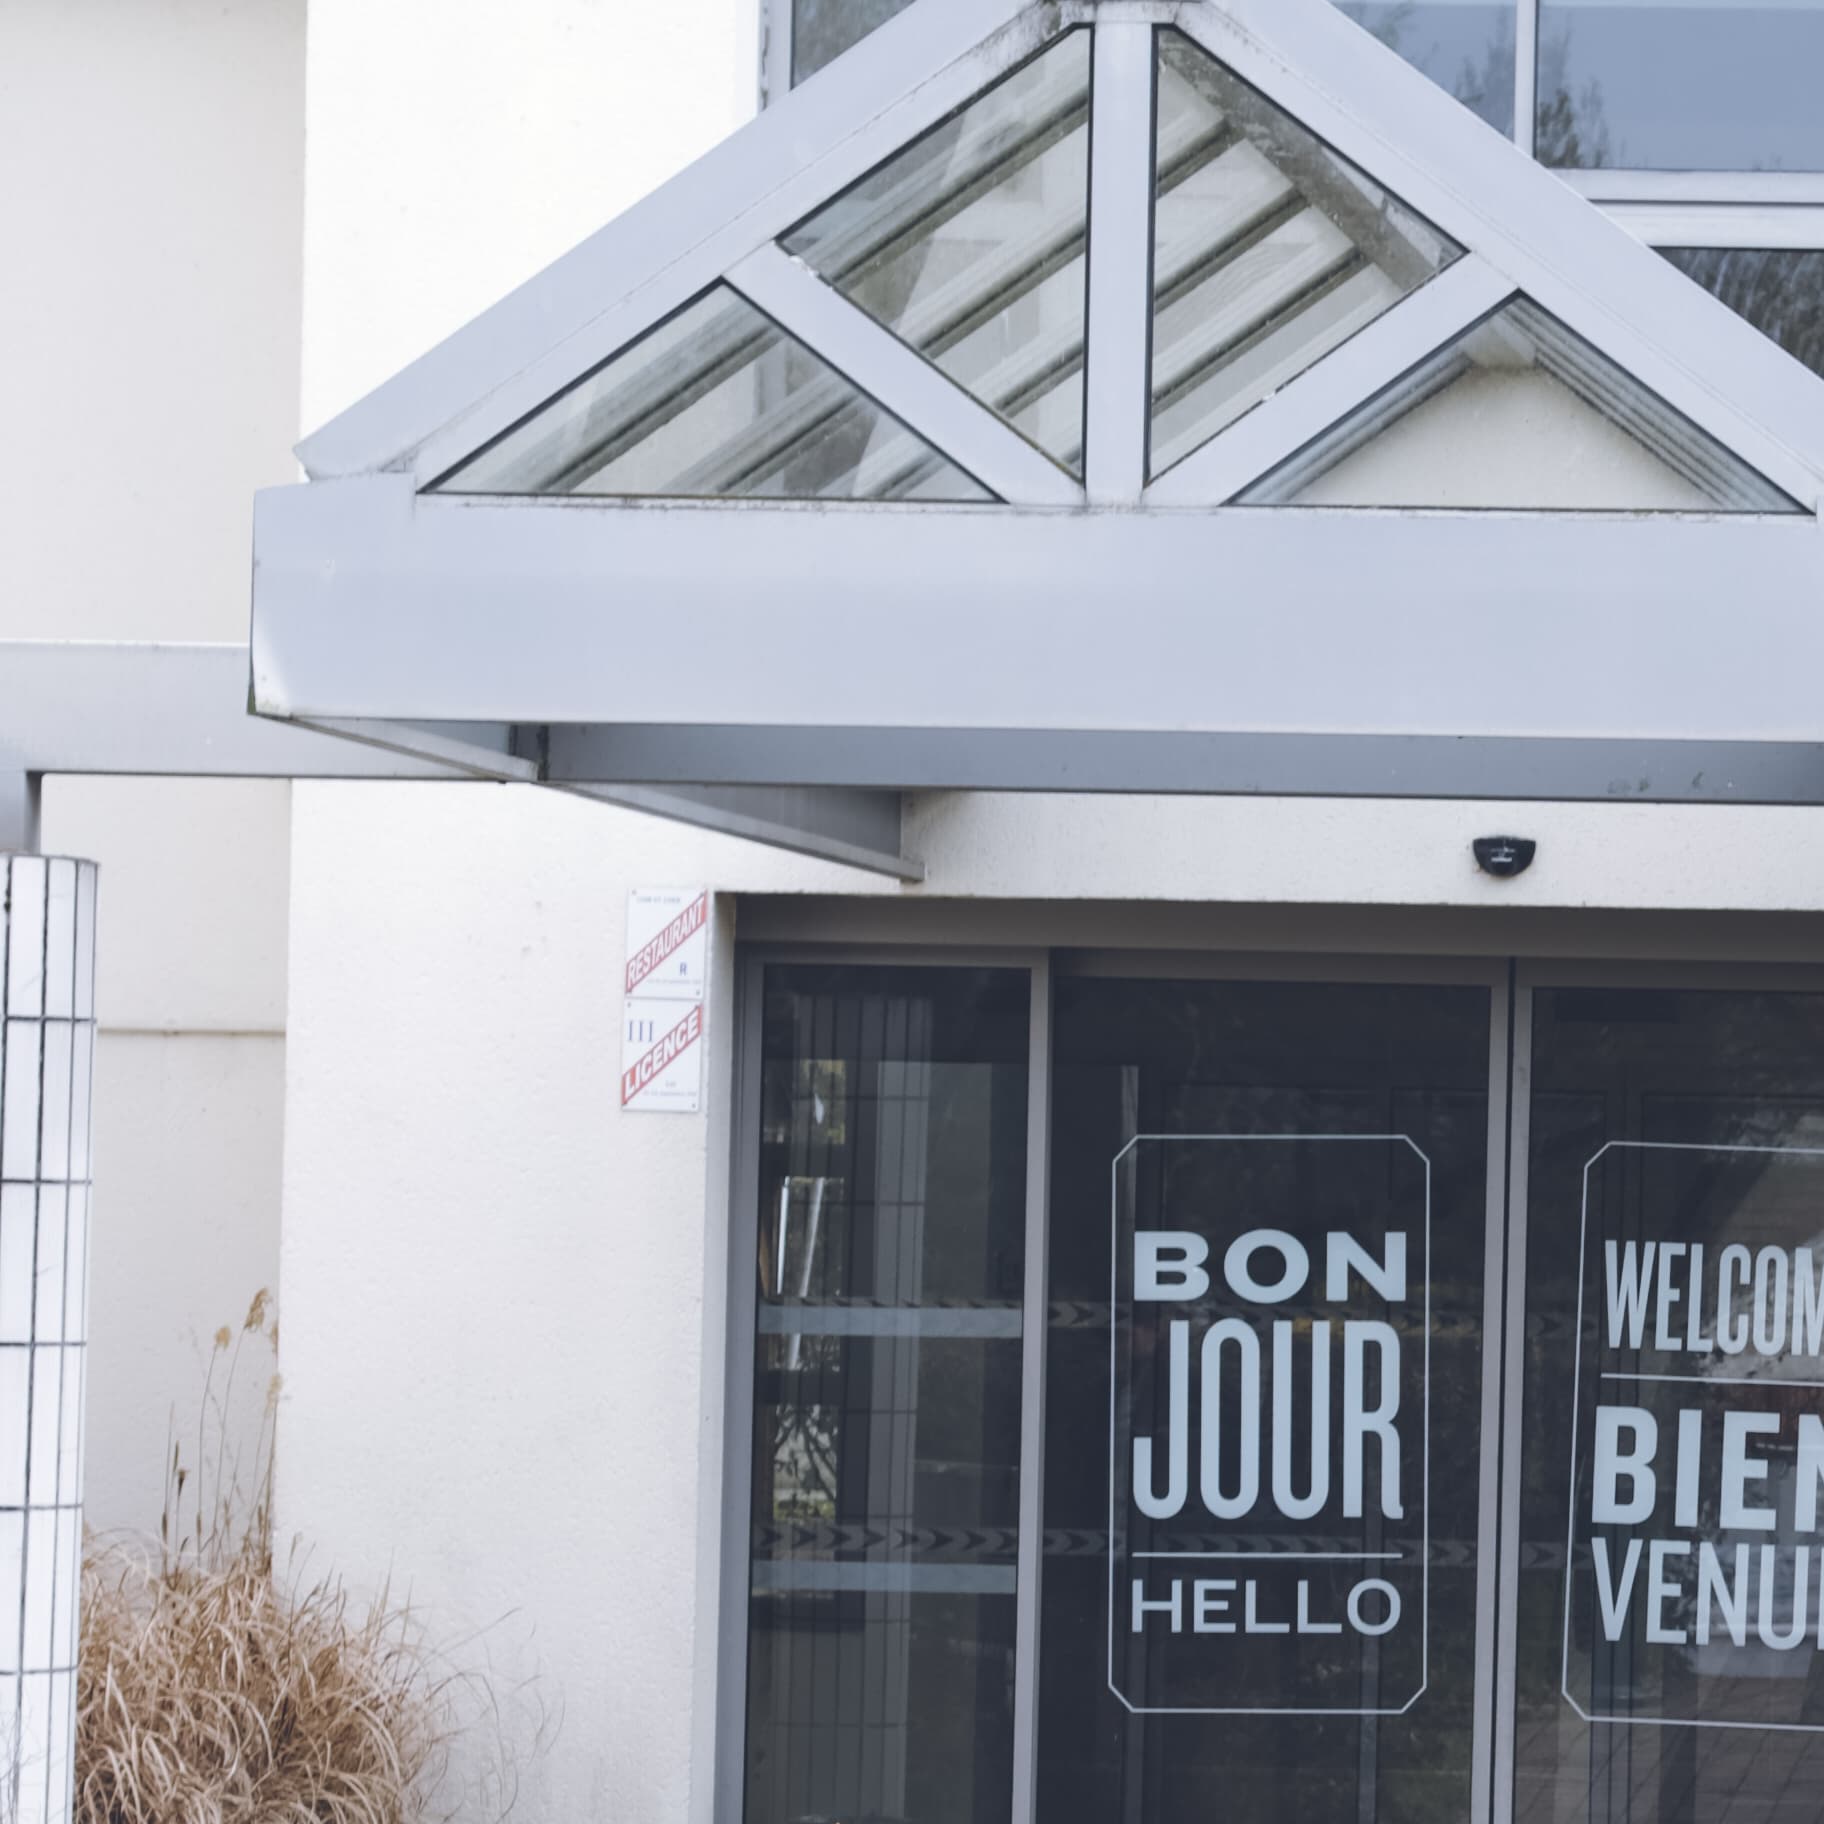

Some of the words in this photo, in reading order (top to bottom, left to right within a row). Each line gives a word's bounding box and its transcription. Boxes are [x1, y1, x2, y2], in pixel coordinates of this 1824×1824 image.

[627, 896, 705, 989] RESTAURANT
[679, 961, 688, 977] R
[624, 1006, 700, 1099] LICENCE
[628, 1020, 654, 1042] III
[1133, 1228, 1407, 1304] BON
[1132, 1317, 1404, 1520] JOUR
[1131, 1578, 1402, 1636] HELLO
